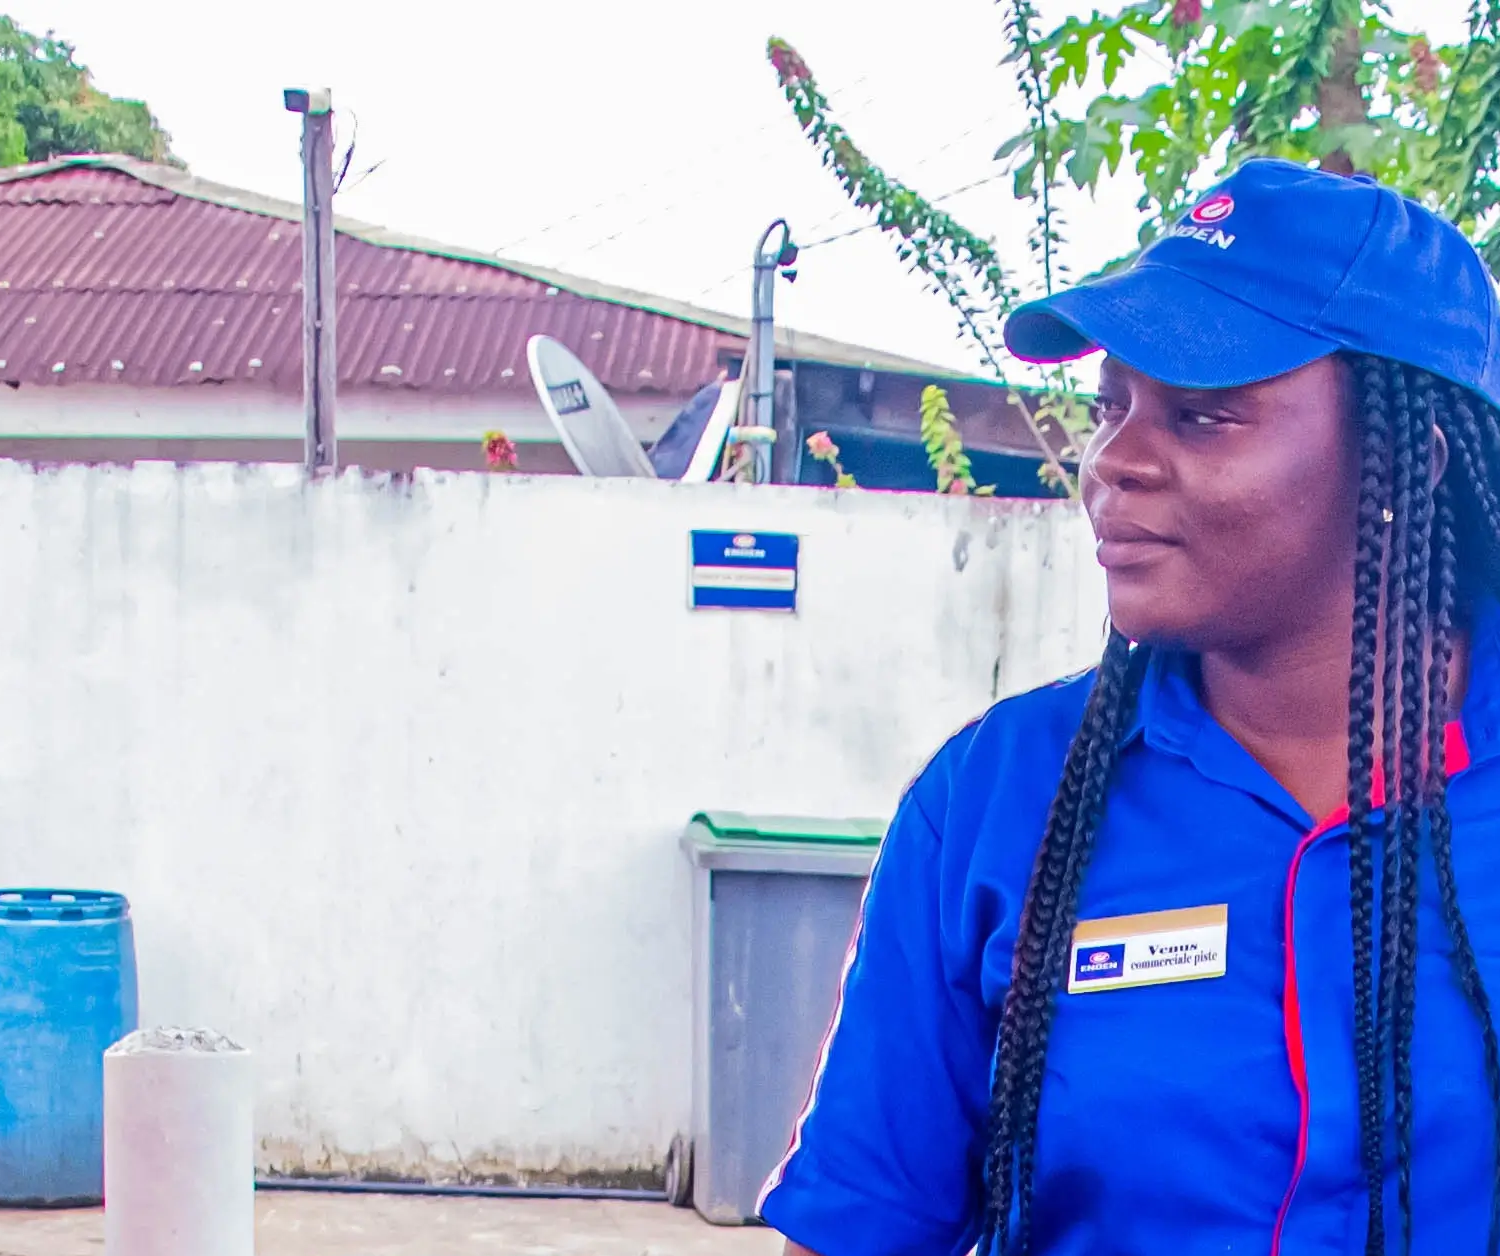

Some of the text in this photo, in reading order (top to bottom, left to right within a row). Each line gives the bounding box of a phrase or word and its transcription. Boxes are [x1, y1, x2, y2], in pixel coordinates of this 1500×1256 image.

[1148, 943, 1199, 956] Venus
[1080, 962, 1118, 973] ENGEN
[1130, 951, 1218, 971] commerciale piste
